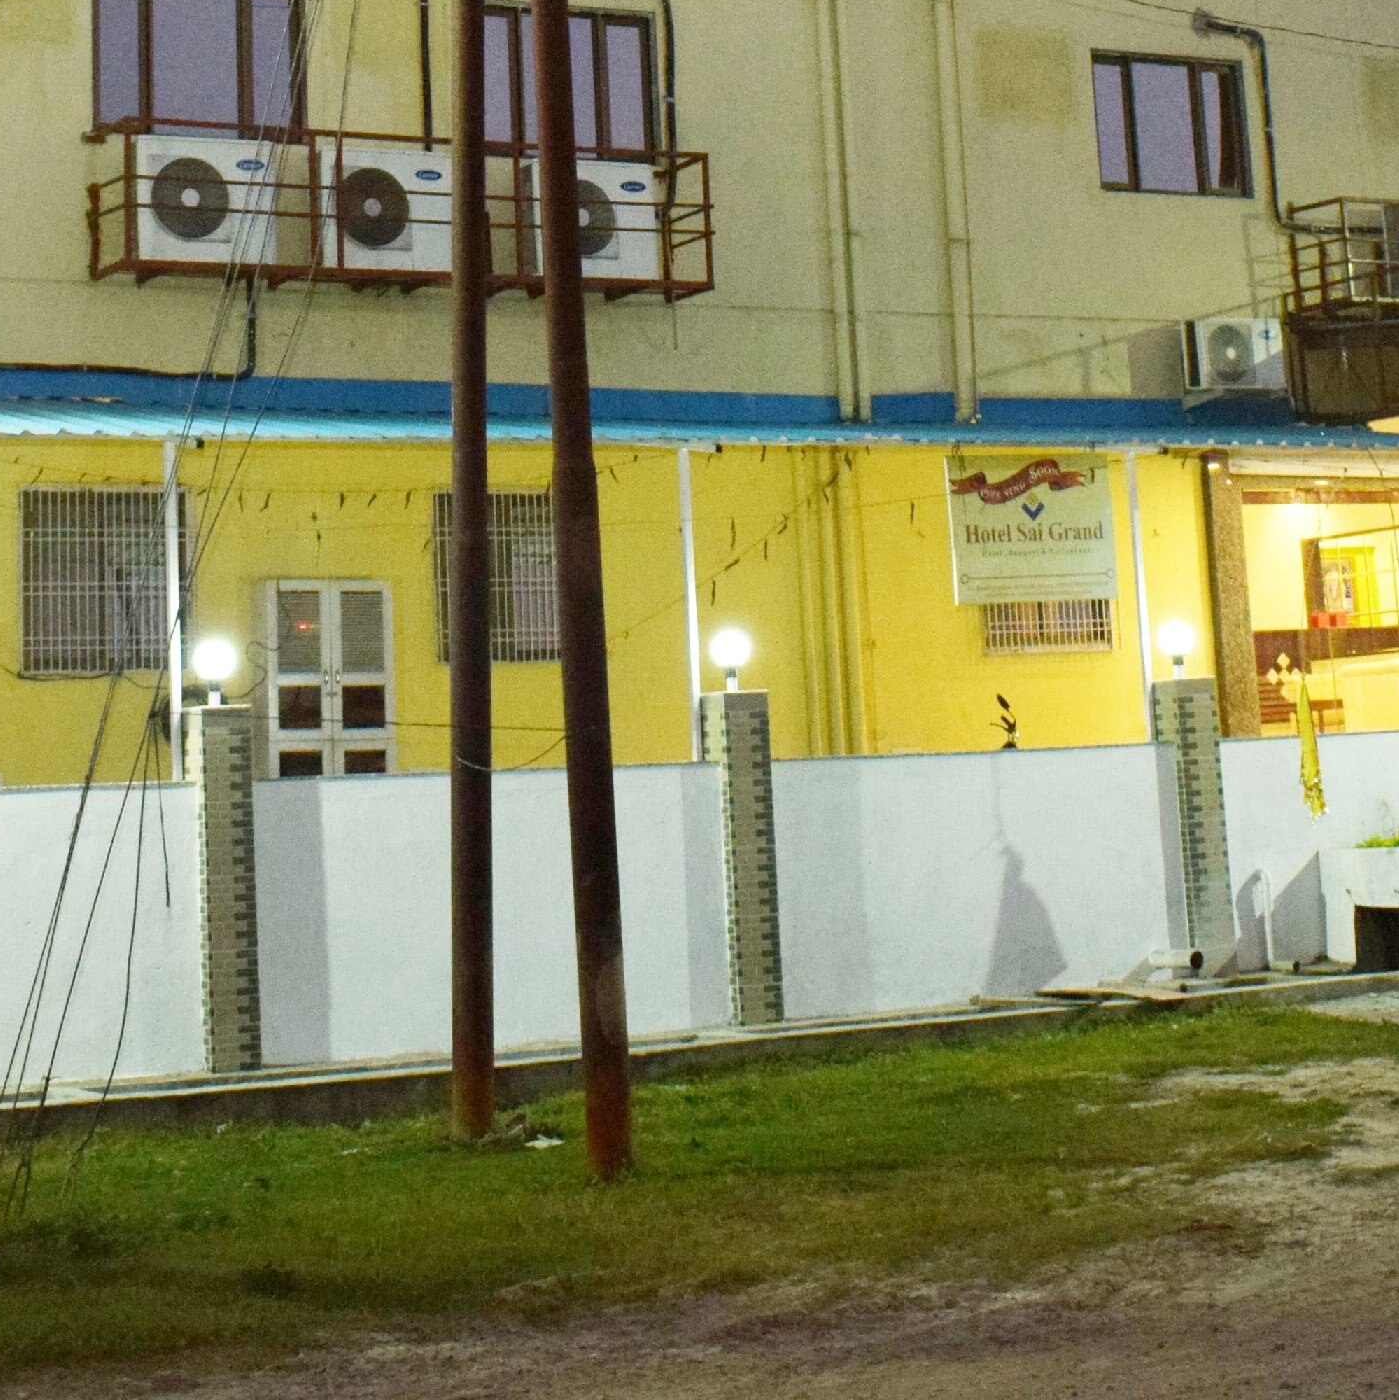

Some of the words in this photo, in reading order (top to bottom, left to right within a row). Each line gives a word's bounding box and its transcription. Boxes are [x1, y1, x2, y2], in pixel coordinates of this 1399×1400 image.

[965, 523, 1012, 545] Hotel
[1017, 522, 1043, 543] Sai
[1049, 520, 1104, 541] Grand
